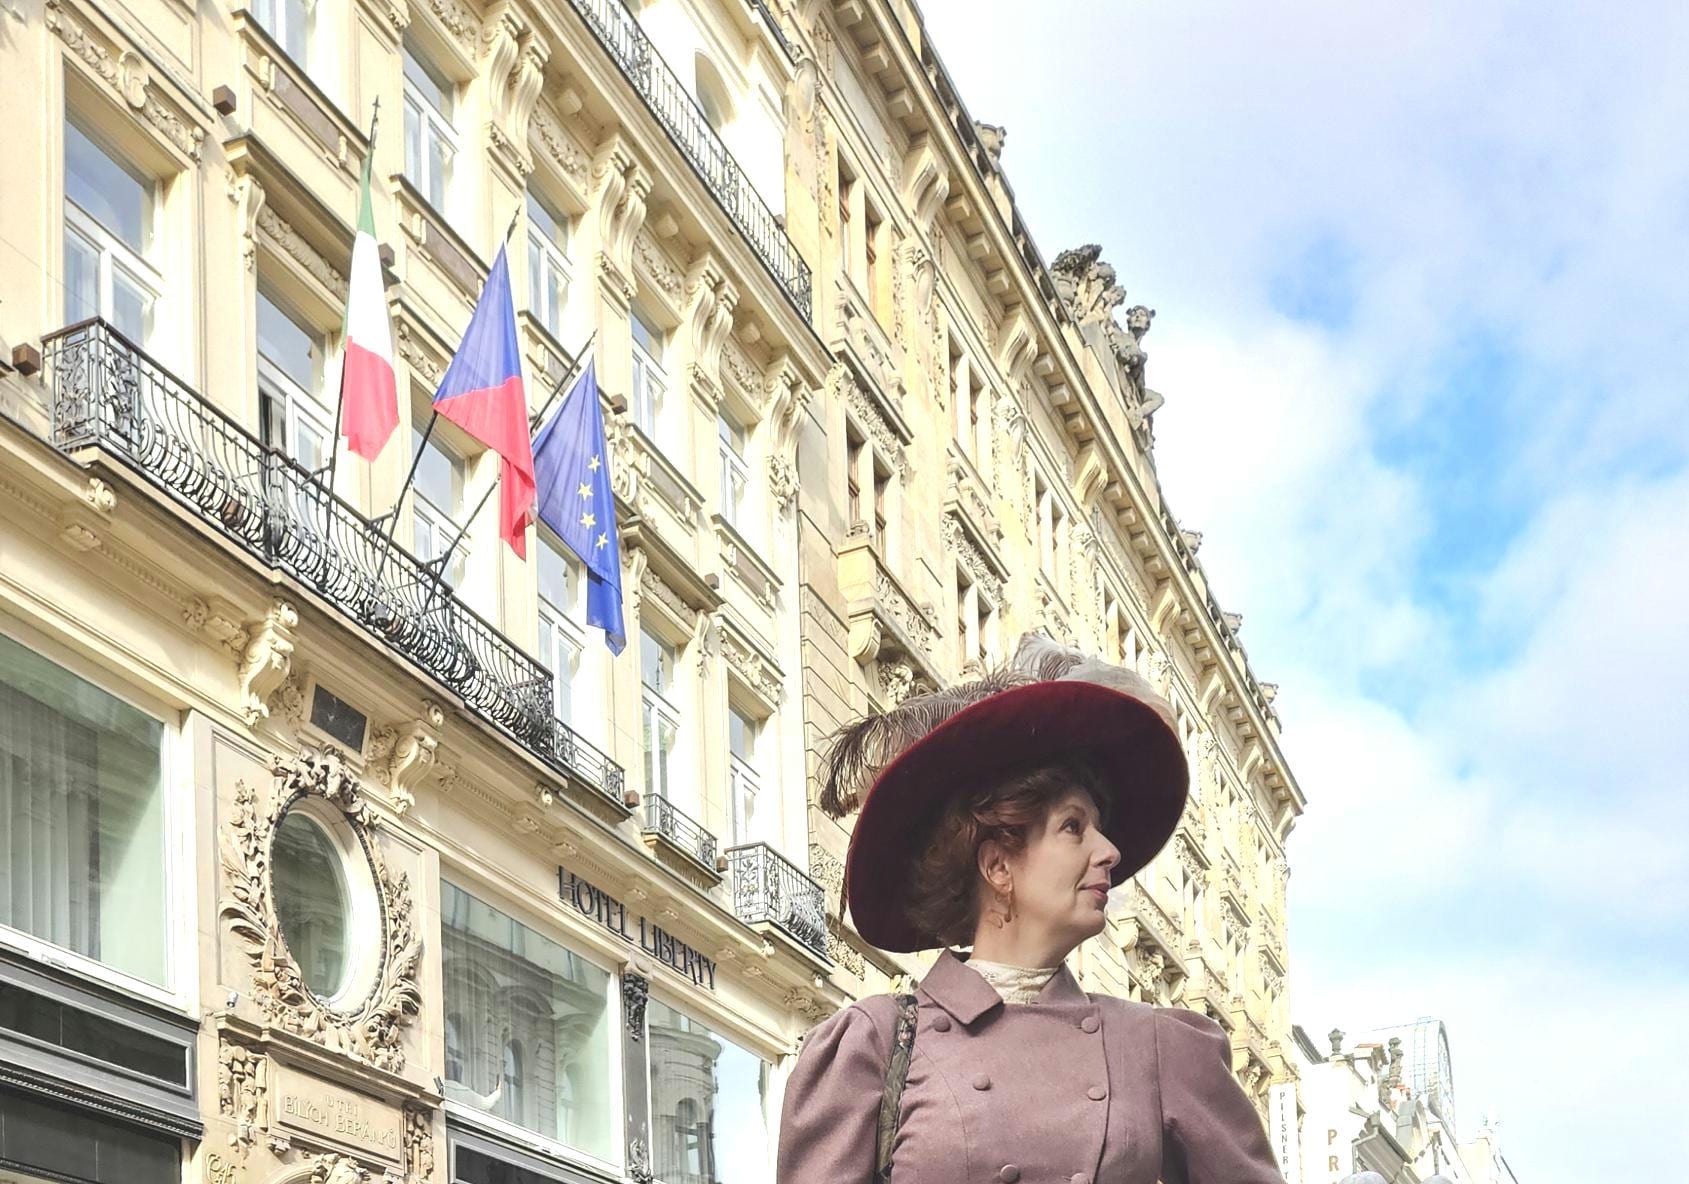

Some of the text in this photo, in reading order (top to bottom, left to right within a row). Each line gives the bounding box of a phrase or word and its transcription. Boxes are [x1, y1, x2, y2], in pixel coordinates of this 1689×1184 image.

[556, 866, 717, 990] HOTEL LIBERTY
[1279, 1091, 1289, 1164] PILSNER
